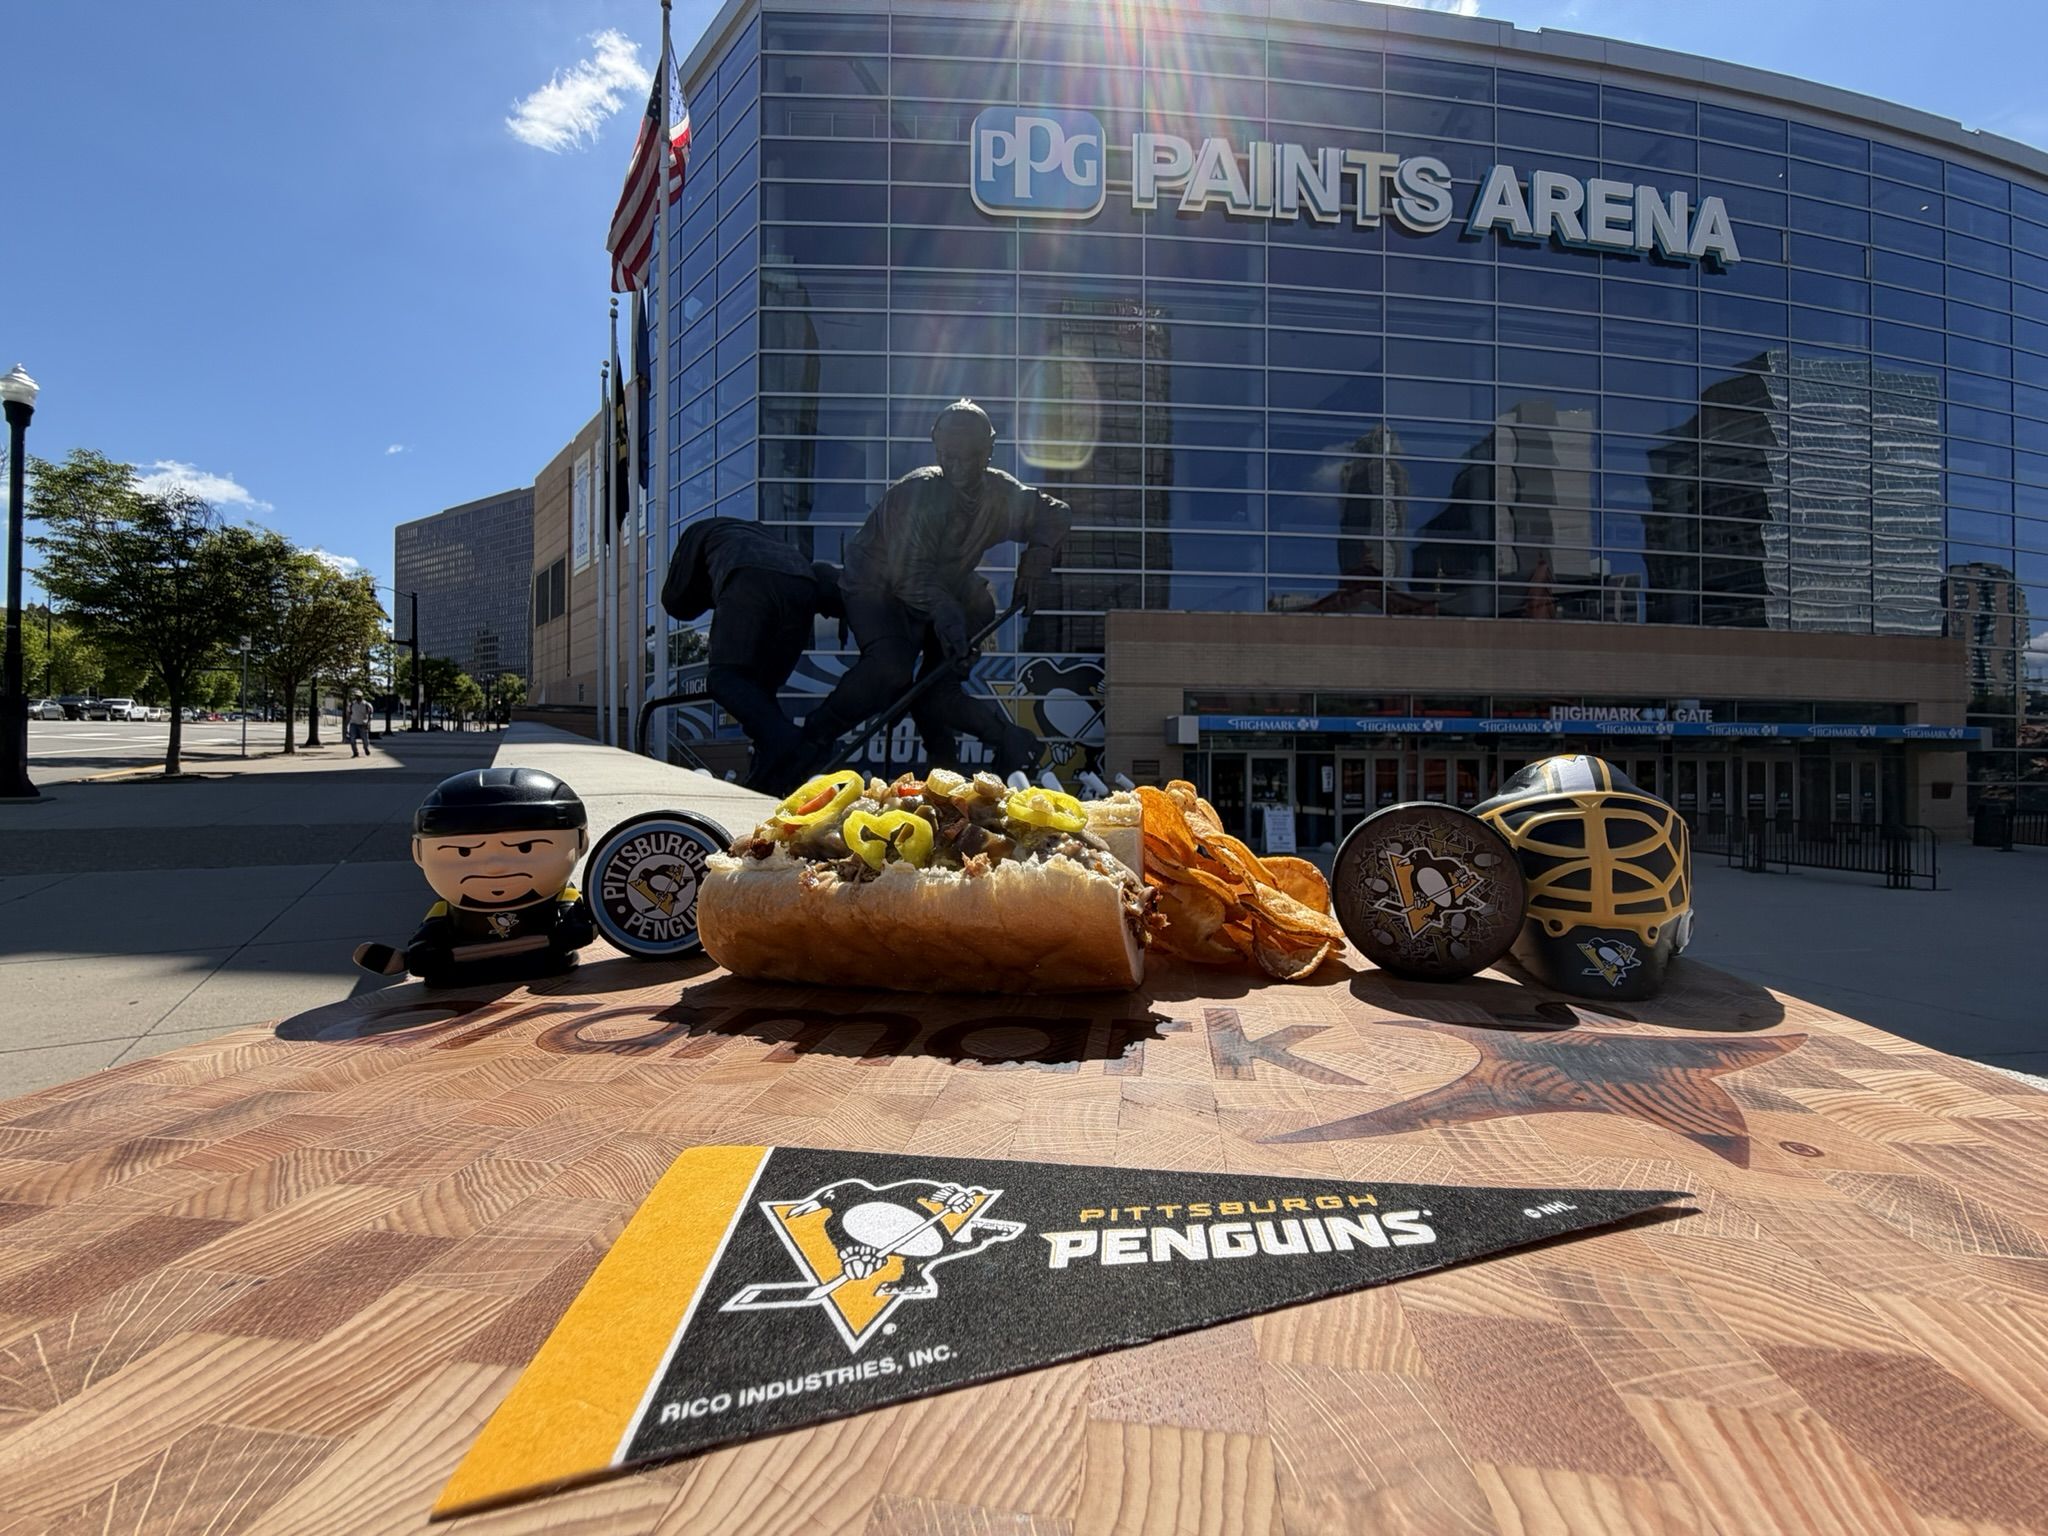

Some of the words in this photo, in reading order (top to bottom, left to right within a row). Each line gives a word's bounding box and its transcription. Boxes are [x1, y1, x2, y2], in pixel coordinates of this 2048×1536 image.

[980, 116, 1097, 198] PPG
[1132, 133, 1453, 232] PAINTS
[1466, 164, 1741, 264] ARENA
[1552, 706, 1641, 722] HIGHMARK
[1675, 708, 1713, 723] GATE
[1229, 718, 1295, 731] HIGHMARK
[1357, 720, 1421, 732] HIGHMARK
[1480, 720, 1541, 732] HIGHMARK
[1597, 722, 1655, 735] HIGHMARK
[1706, 724, 1760, 737] HIGHMARK
[1808, 724, 1859, 737] HIGHMARK
[1903, 727, 1949, 739] HIGHMARK
[1080, 1194, 1378, 1223] PITTSBURGH
[1039, 1209, 1436, 1269] PENGUINS
[660, 1394, 732, 1424] RICO
[739, 1356, 903, 1407] INDUSTRIES,
[908, 1344, 958, 1368] INC.
